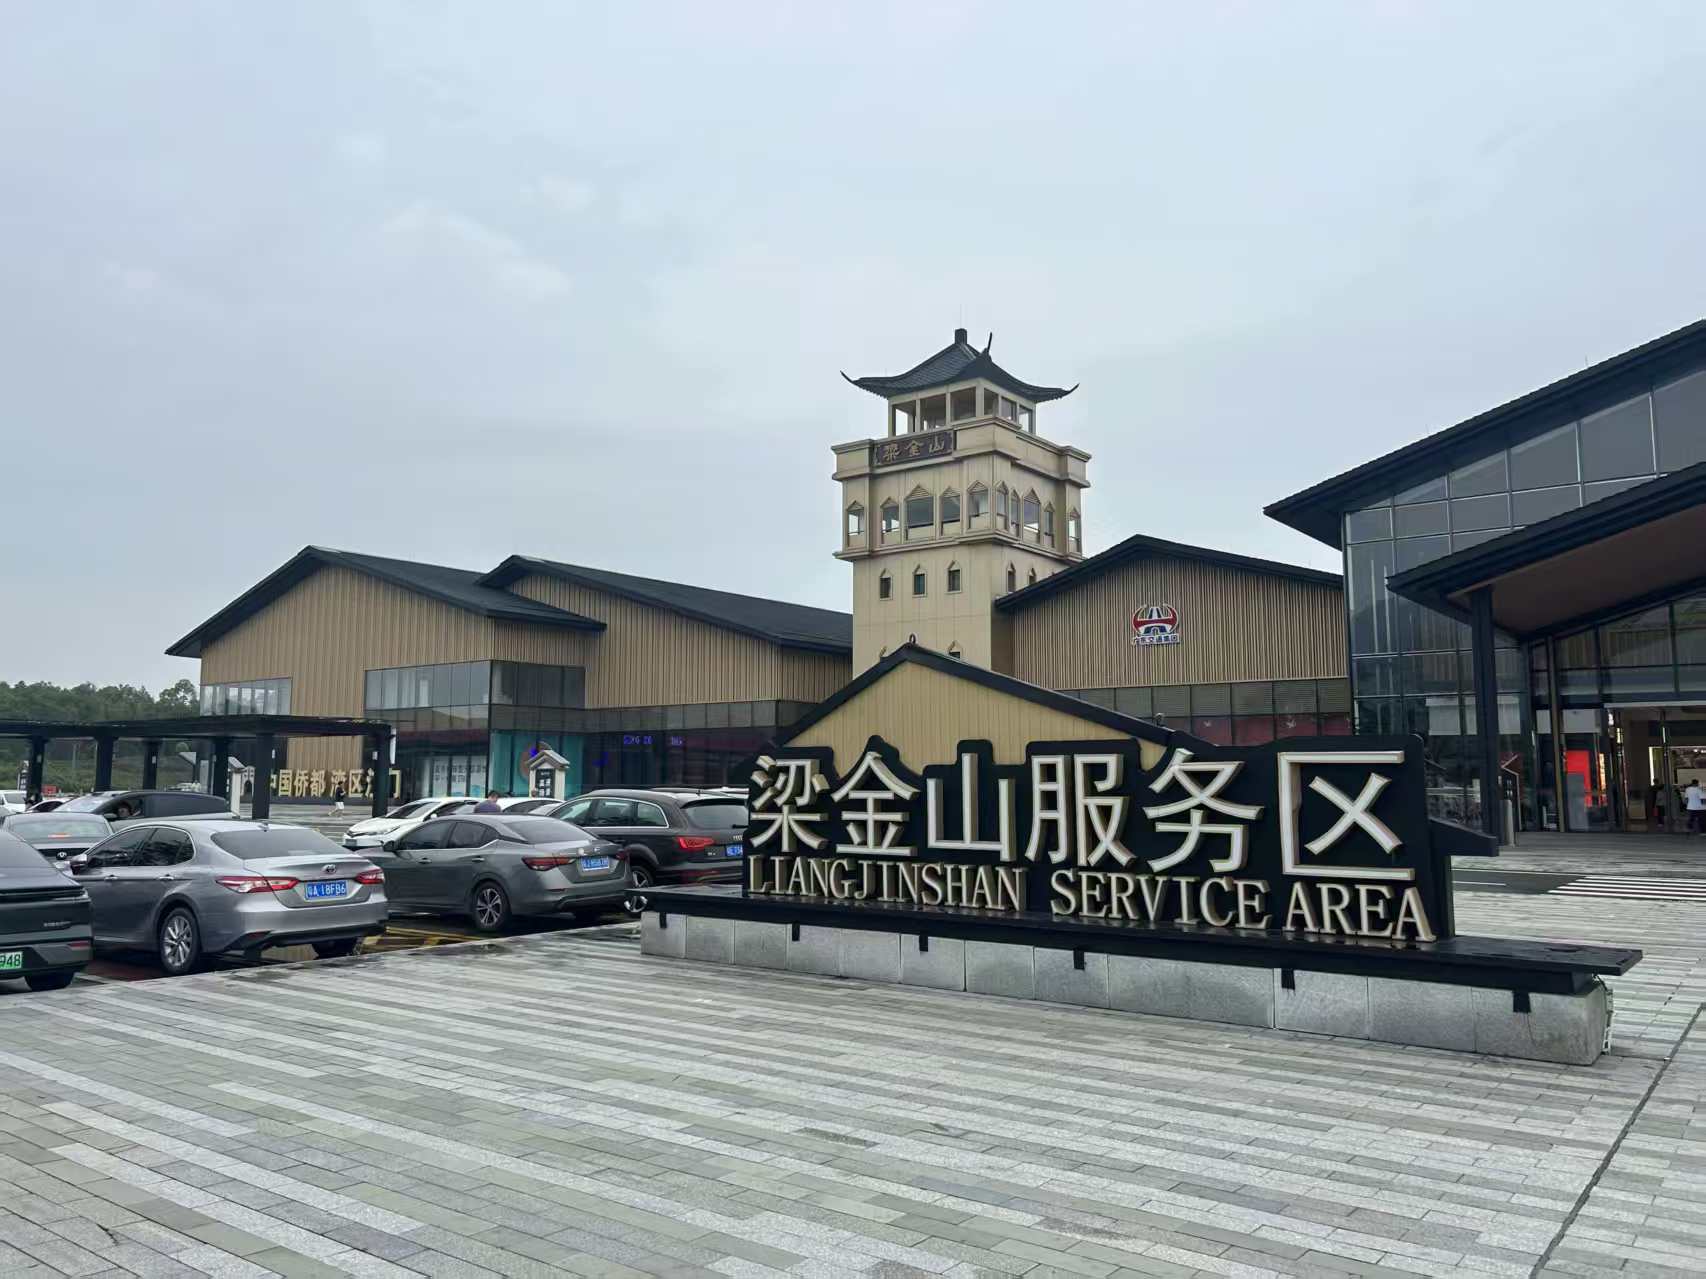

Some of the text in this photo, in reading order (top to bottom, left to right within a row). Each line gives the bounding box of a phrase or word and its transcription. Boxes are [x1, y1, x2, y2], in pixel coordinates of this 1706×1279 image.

[750, 748, 1416, 881] 梁金山服务区
[748, 854, 1438, 944] LIANGJINSHAN SERVICE AREA
